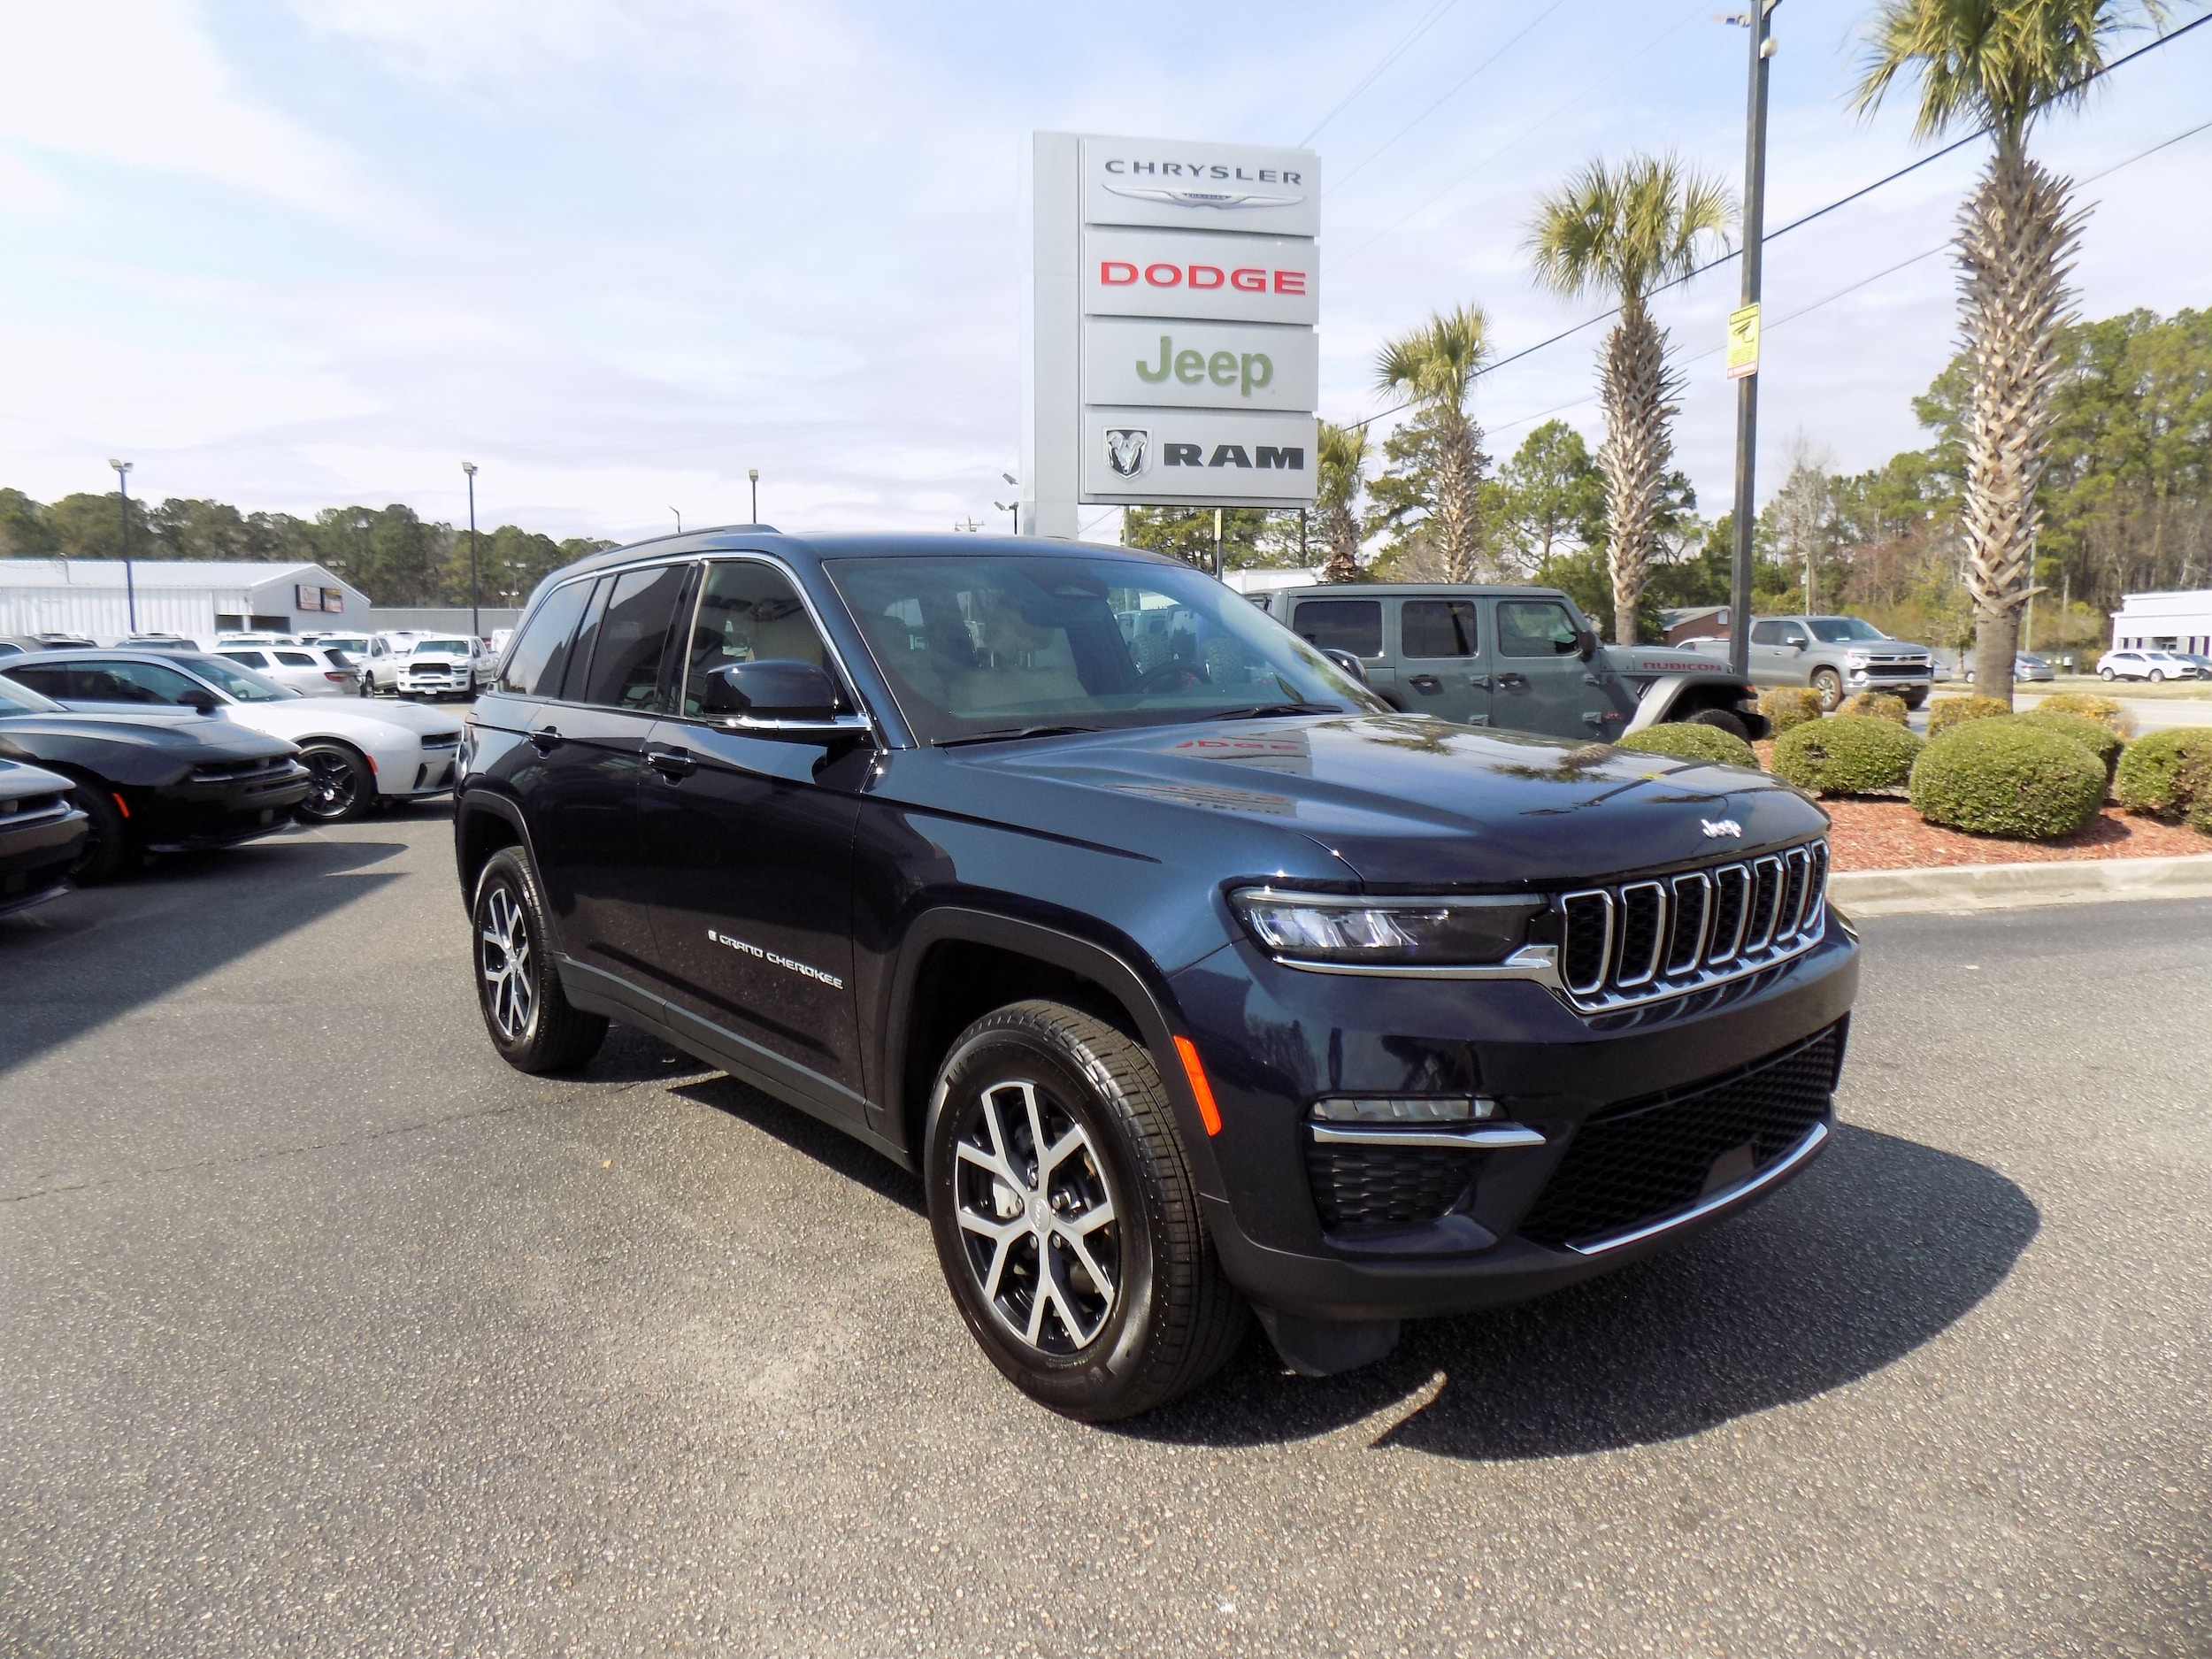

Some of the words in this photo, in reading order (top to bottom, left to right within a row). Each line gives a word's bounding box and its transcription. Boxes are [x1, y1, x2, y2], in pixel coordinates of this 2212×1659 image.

[1104, 159, 1302, 185] CHRYSLER
[1101, 261, 1306, 296] DODGE
[1135, 334, 1273, 396] Jeep
[1163, 443, 1304, 471] RAM
[1642, 662, 1722, 671] RUBICON
[1701, 818, 1742, 839] Jeep
[718, 934, 764, 958] GRAND
[766, 952, 844, 990] CHEROKEE
